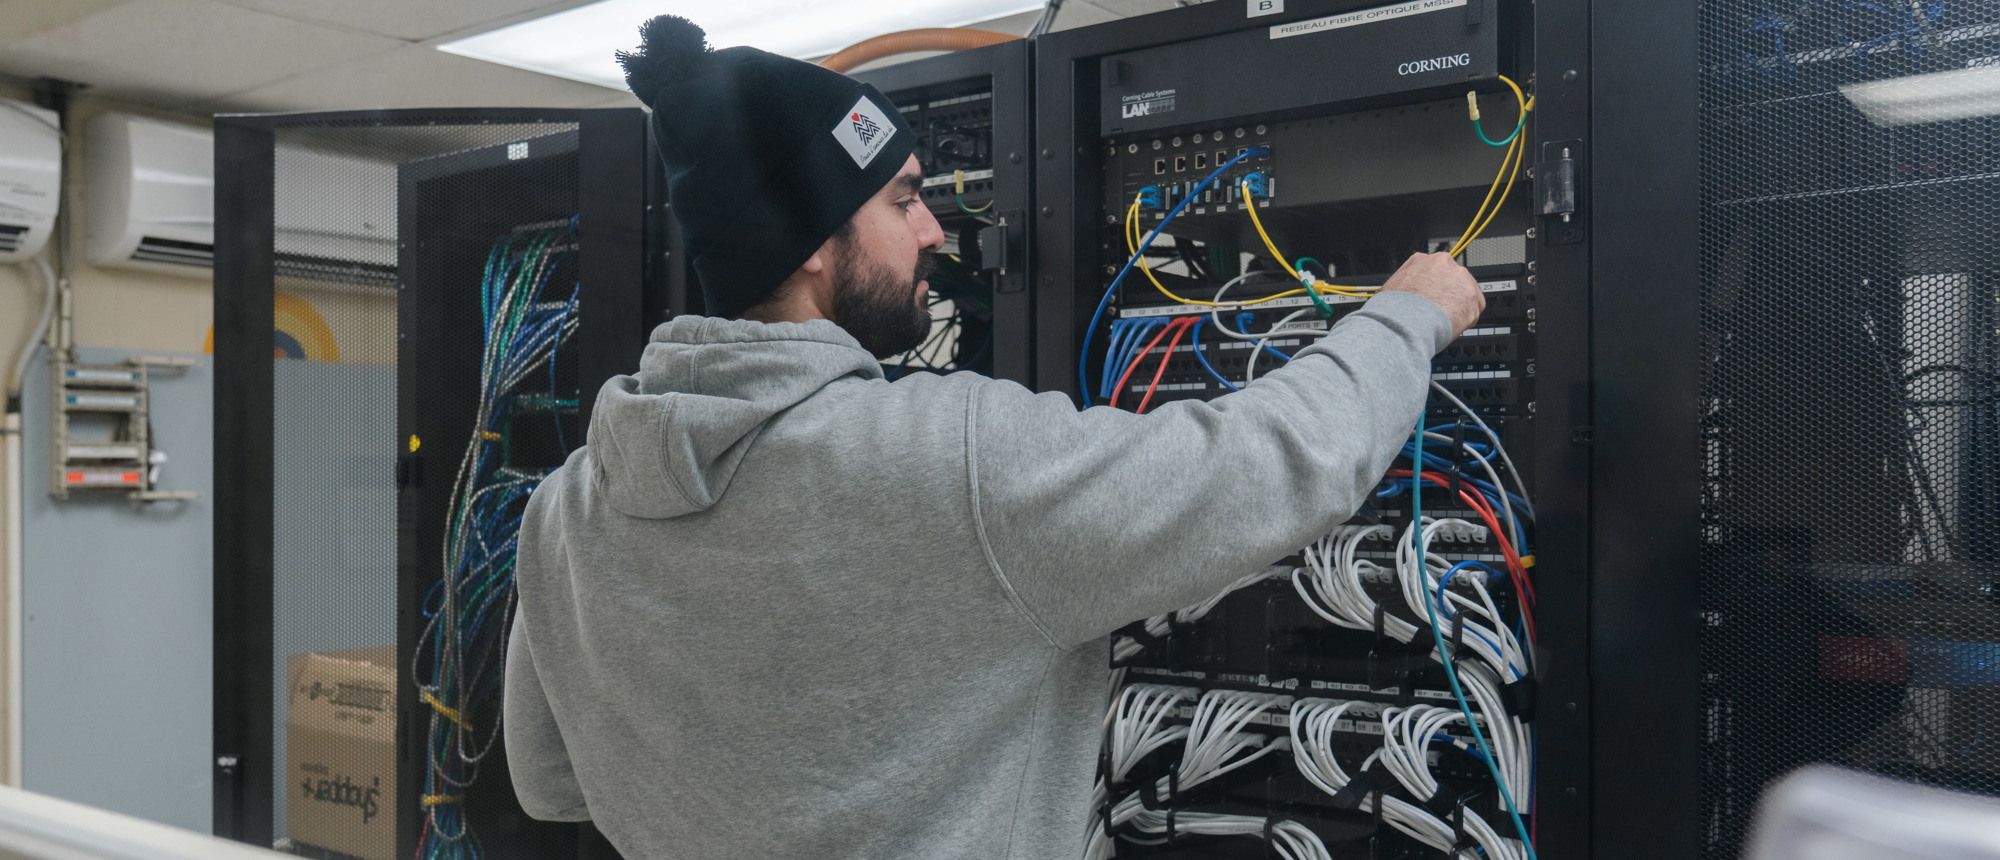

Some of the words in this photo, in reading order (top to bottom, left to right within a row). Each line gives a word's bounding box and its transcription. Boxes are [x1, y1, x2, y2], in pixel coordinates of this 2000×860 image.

[1259, 0, 1273, 11] B
[1281, 20, 1327, 34] RESEAU
[1329, 13, 1364, 26] FIBRE
[1366, 3, 1420, 19] OPTIQUE
[1397, 53, 1471, 76] CORNING
[1141, 91, 1155, 99] Cable
[1155, 89, 1176, 98] Systems
[1273, 716, 1283, 724] 83
[1357, 723, 1366, 731] 88
[1372, 724, 1382, 732] 89
